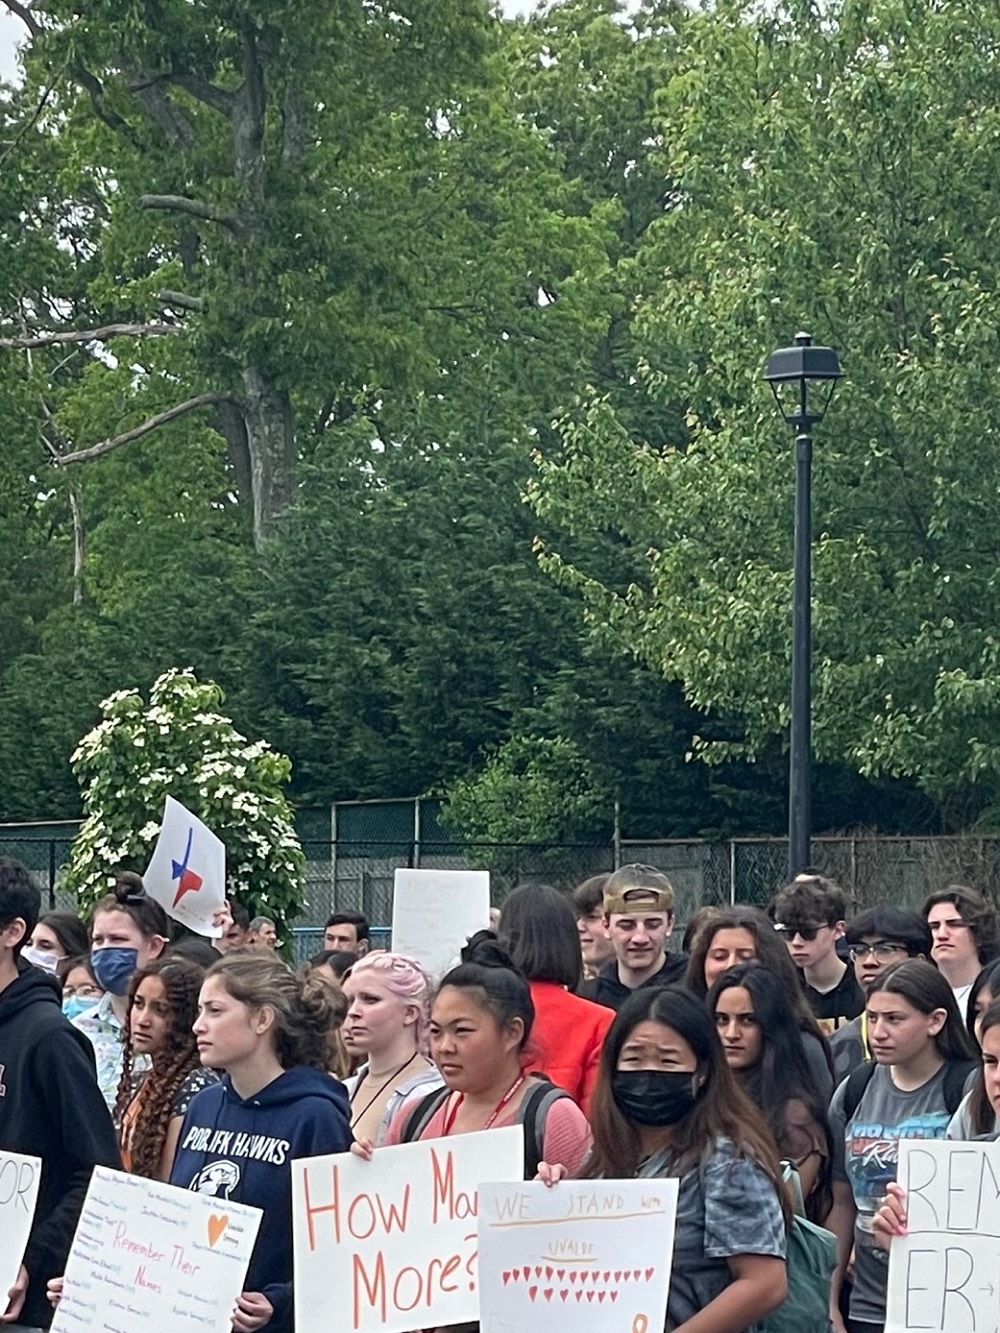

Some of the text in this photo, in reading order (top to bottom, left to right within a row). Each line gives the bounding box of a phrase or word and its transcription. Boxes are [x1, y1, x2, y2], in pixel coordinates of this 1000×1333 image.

[230, 1132, 290, 1165] HAWKS
[304, 1165, 410, 1251] How
[495, 1192, 533, 1220] WE
[564, 1194, 624, 1218] STAND
[113, 1221, 165, 1261] Remember
[171, 1245, 201, 1276] Their
[548, 1238, 595, 1256] UVALDE
[134, 1265, 161, 1293] Names
[353, 1233, 478, 1329] More?
[905, 1247, 976, 1332] ER
